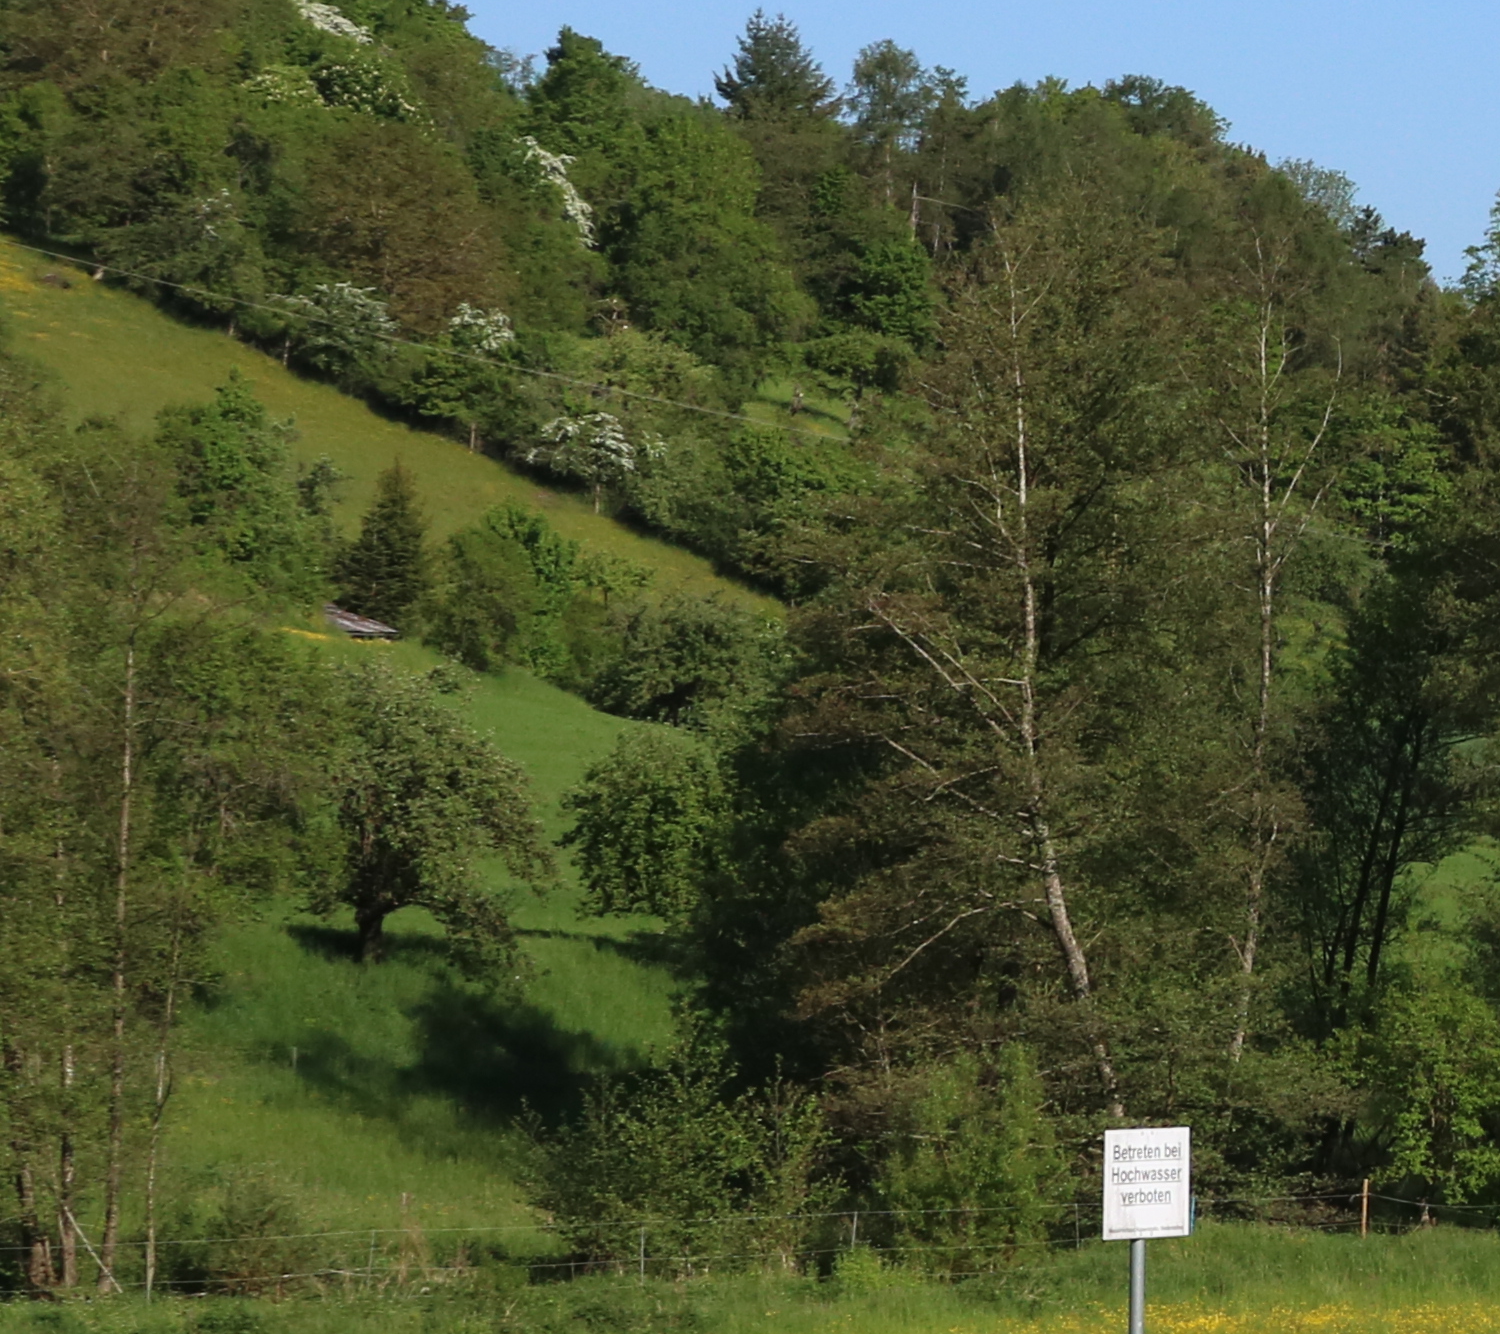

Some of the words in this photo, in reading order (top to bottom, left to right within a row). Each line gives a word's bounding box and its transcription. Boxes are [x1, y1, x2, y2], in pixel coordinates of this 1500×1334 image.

[1113, 1144, 1161, 1161] Betreten
[1164, 1142, 1181, 1158] bei
[1112, 1167, 1182, 1183] Hochwasser
[1120, 1189, 1171, 1205] verboten
